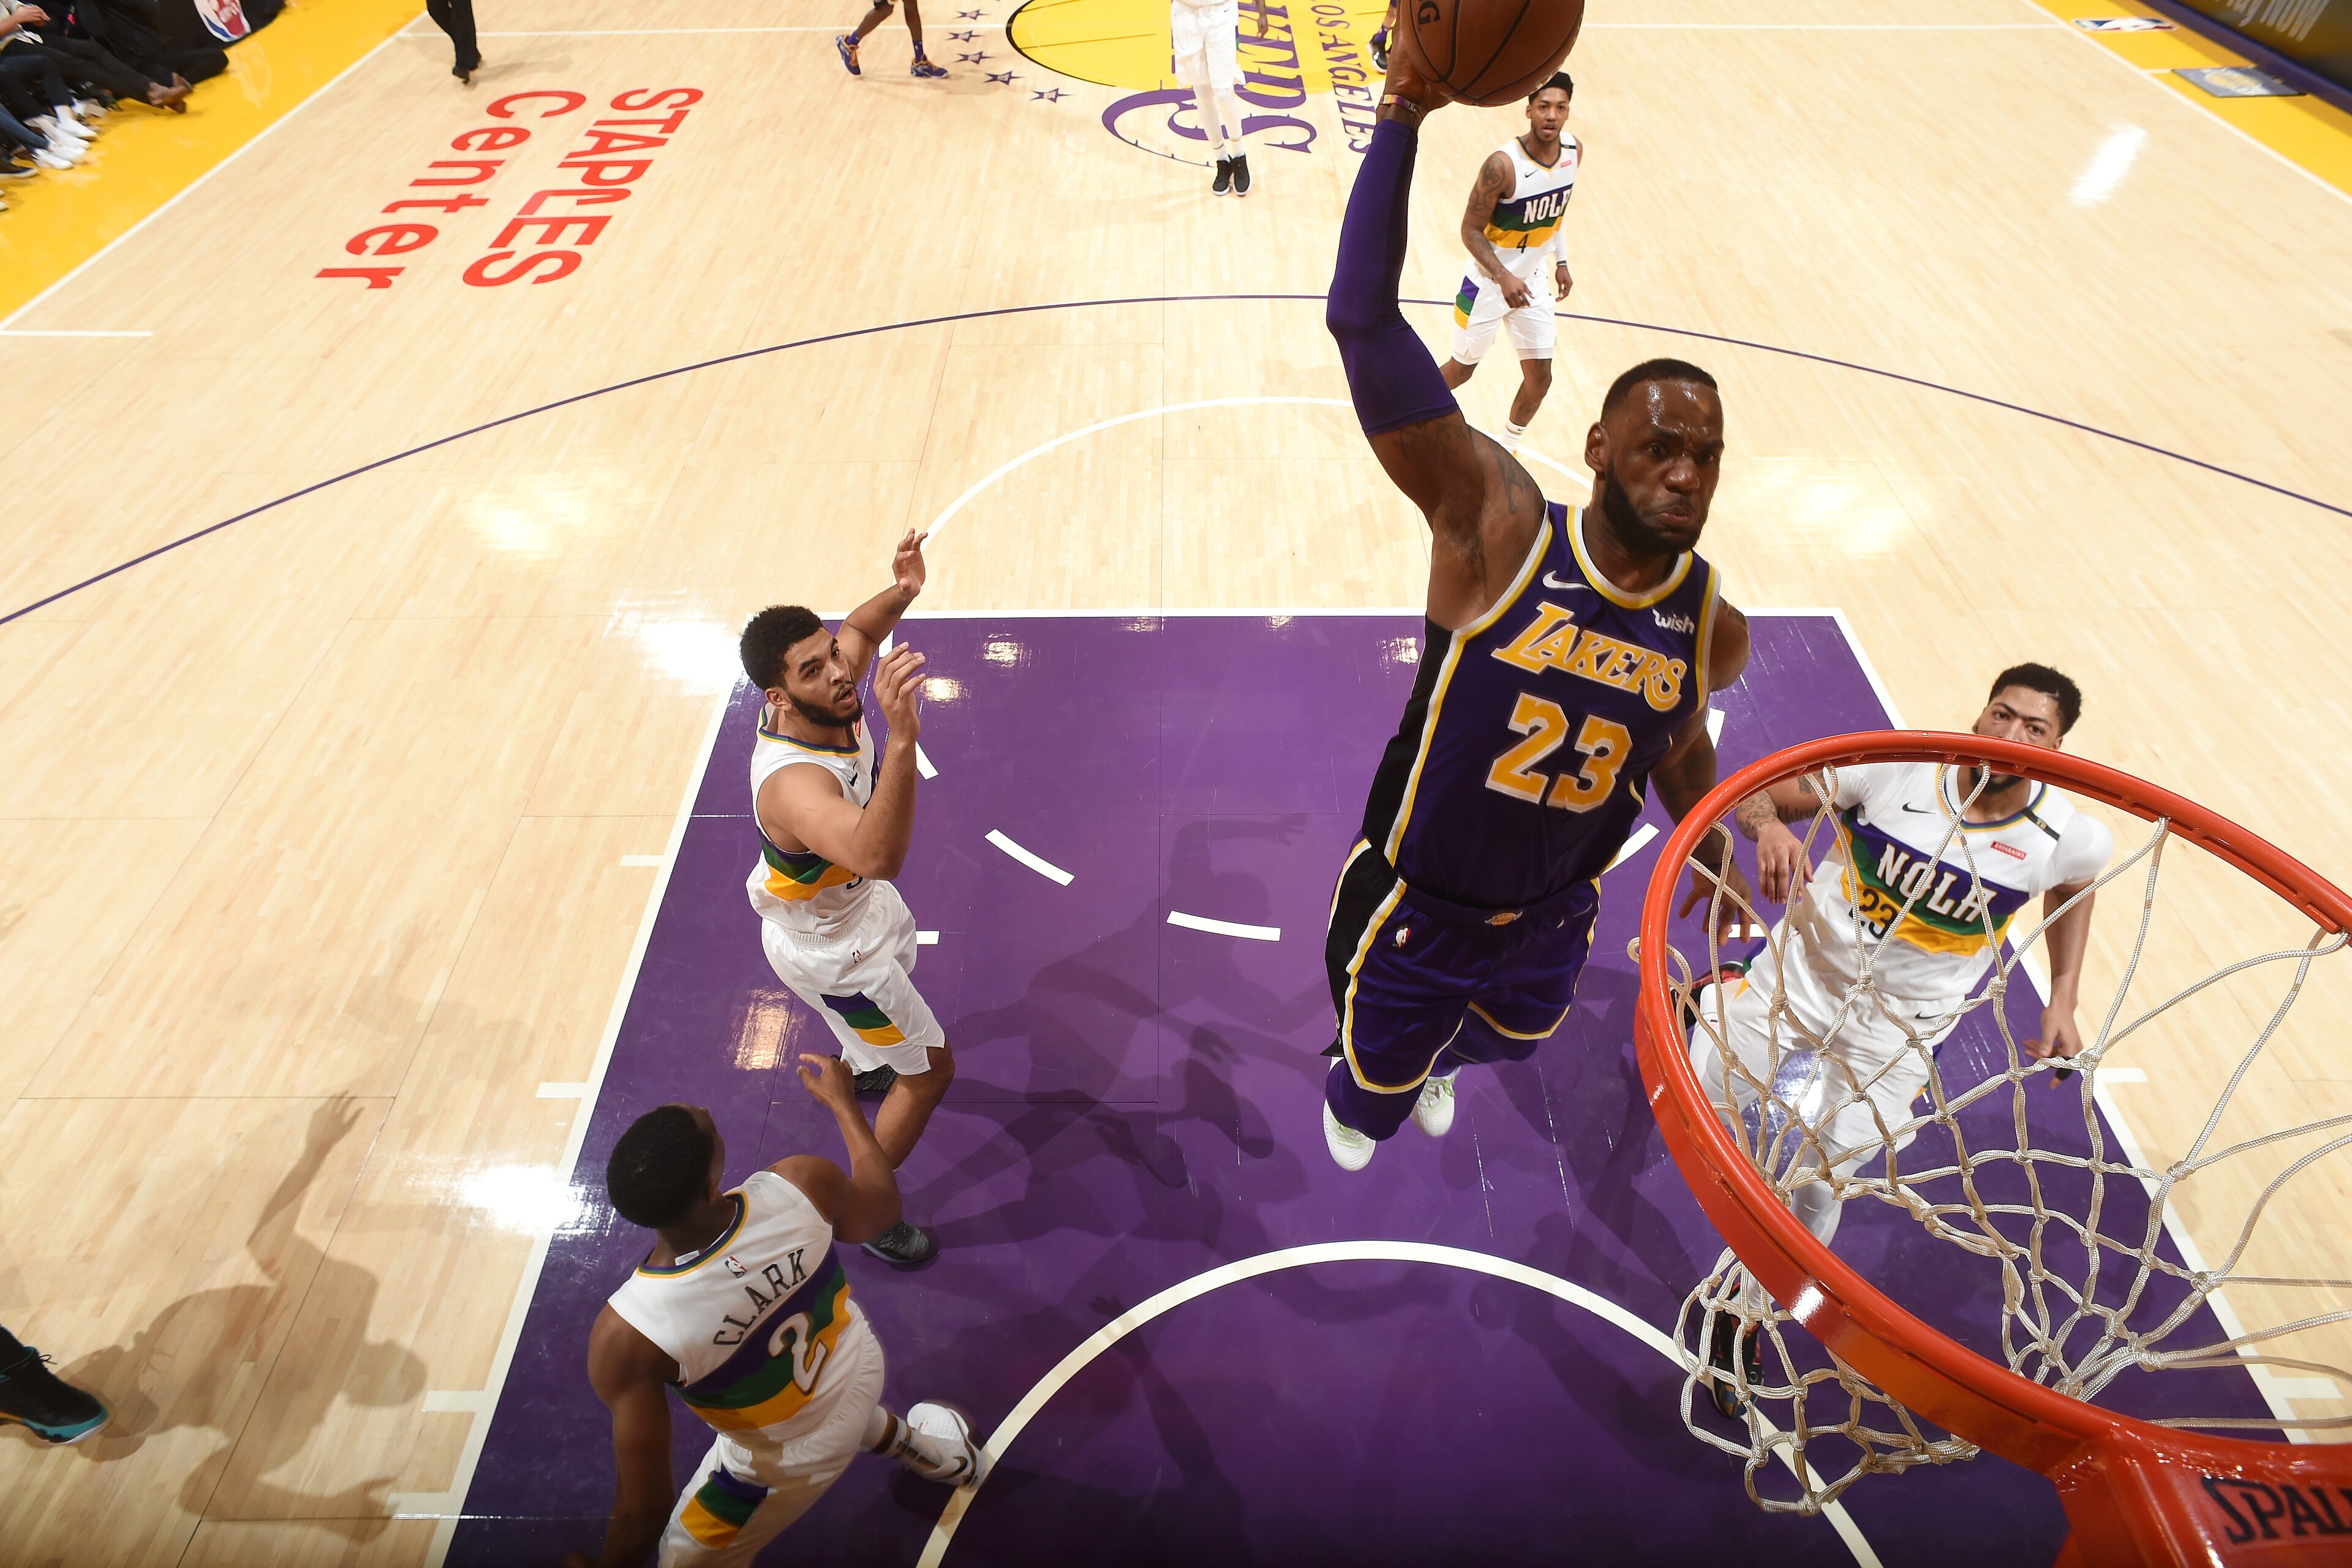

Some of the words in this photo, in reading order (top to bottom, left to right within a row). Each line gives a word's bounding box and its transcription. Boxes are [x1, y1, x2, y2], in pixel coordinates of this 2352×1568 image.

[1311, 0, 1350, 28] OS
[314, 90, 587, 288] Center
[462, 88, 704, 287] STAPLES
[1516, 233, 1529, 254] 4
[1490, 600, 1688, 713] LAKERS
[1652, 608, 1695, 635] wish
[1484, 692, 1634, 814] 23
[1849, 888, 1899, 939] 23
[1875, 842, 1998, 924] NOLA
[713, 1248, 807, 1345] CLARK
[767, 1312, 829, 1396] 2
[2201, 1476, 2352, 1545] SPAL
